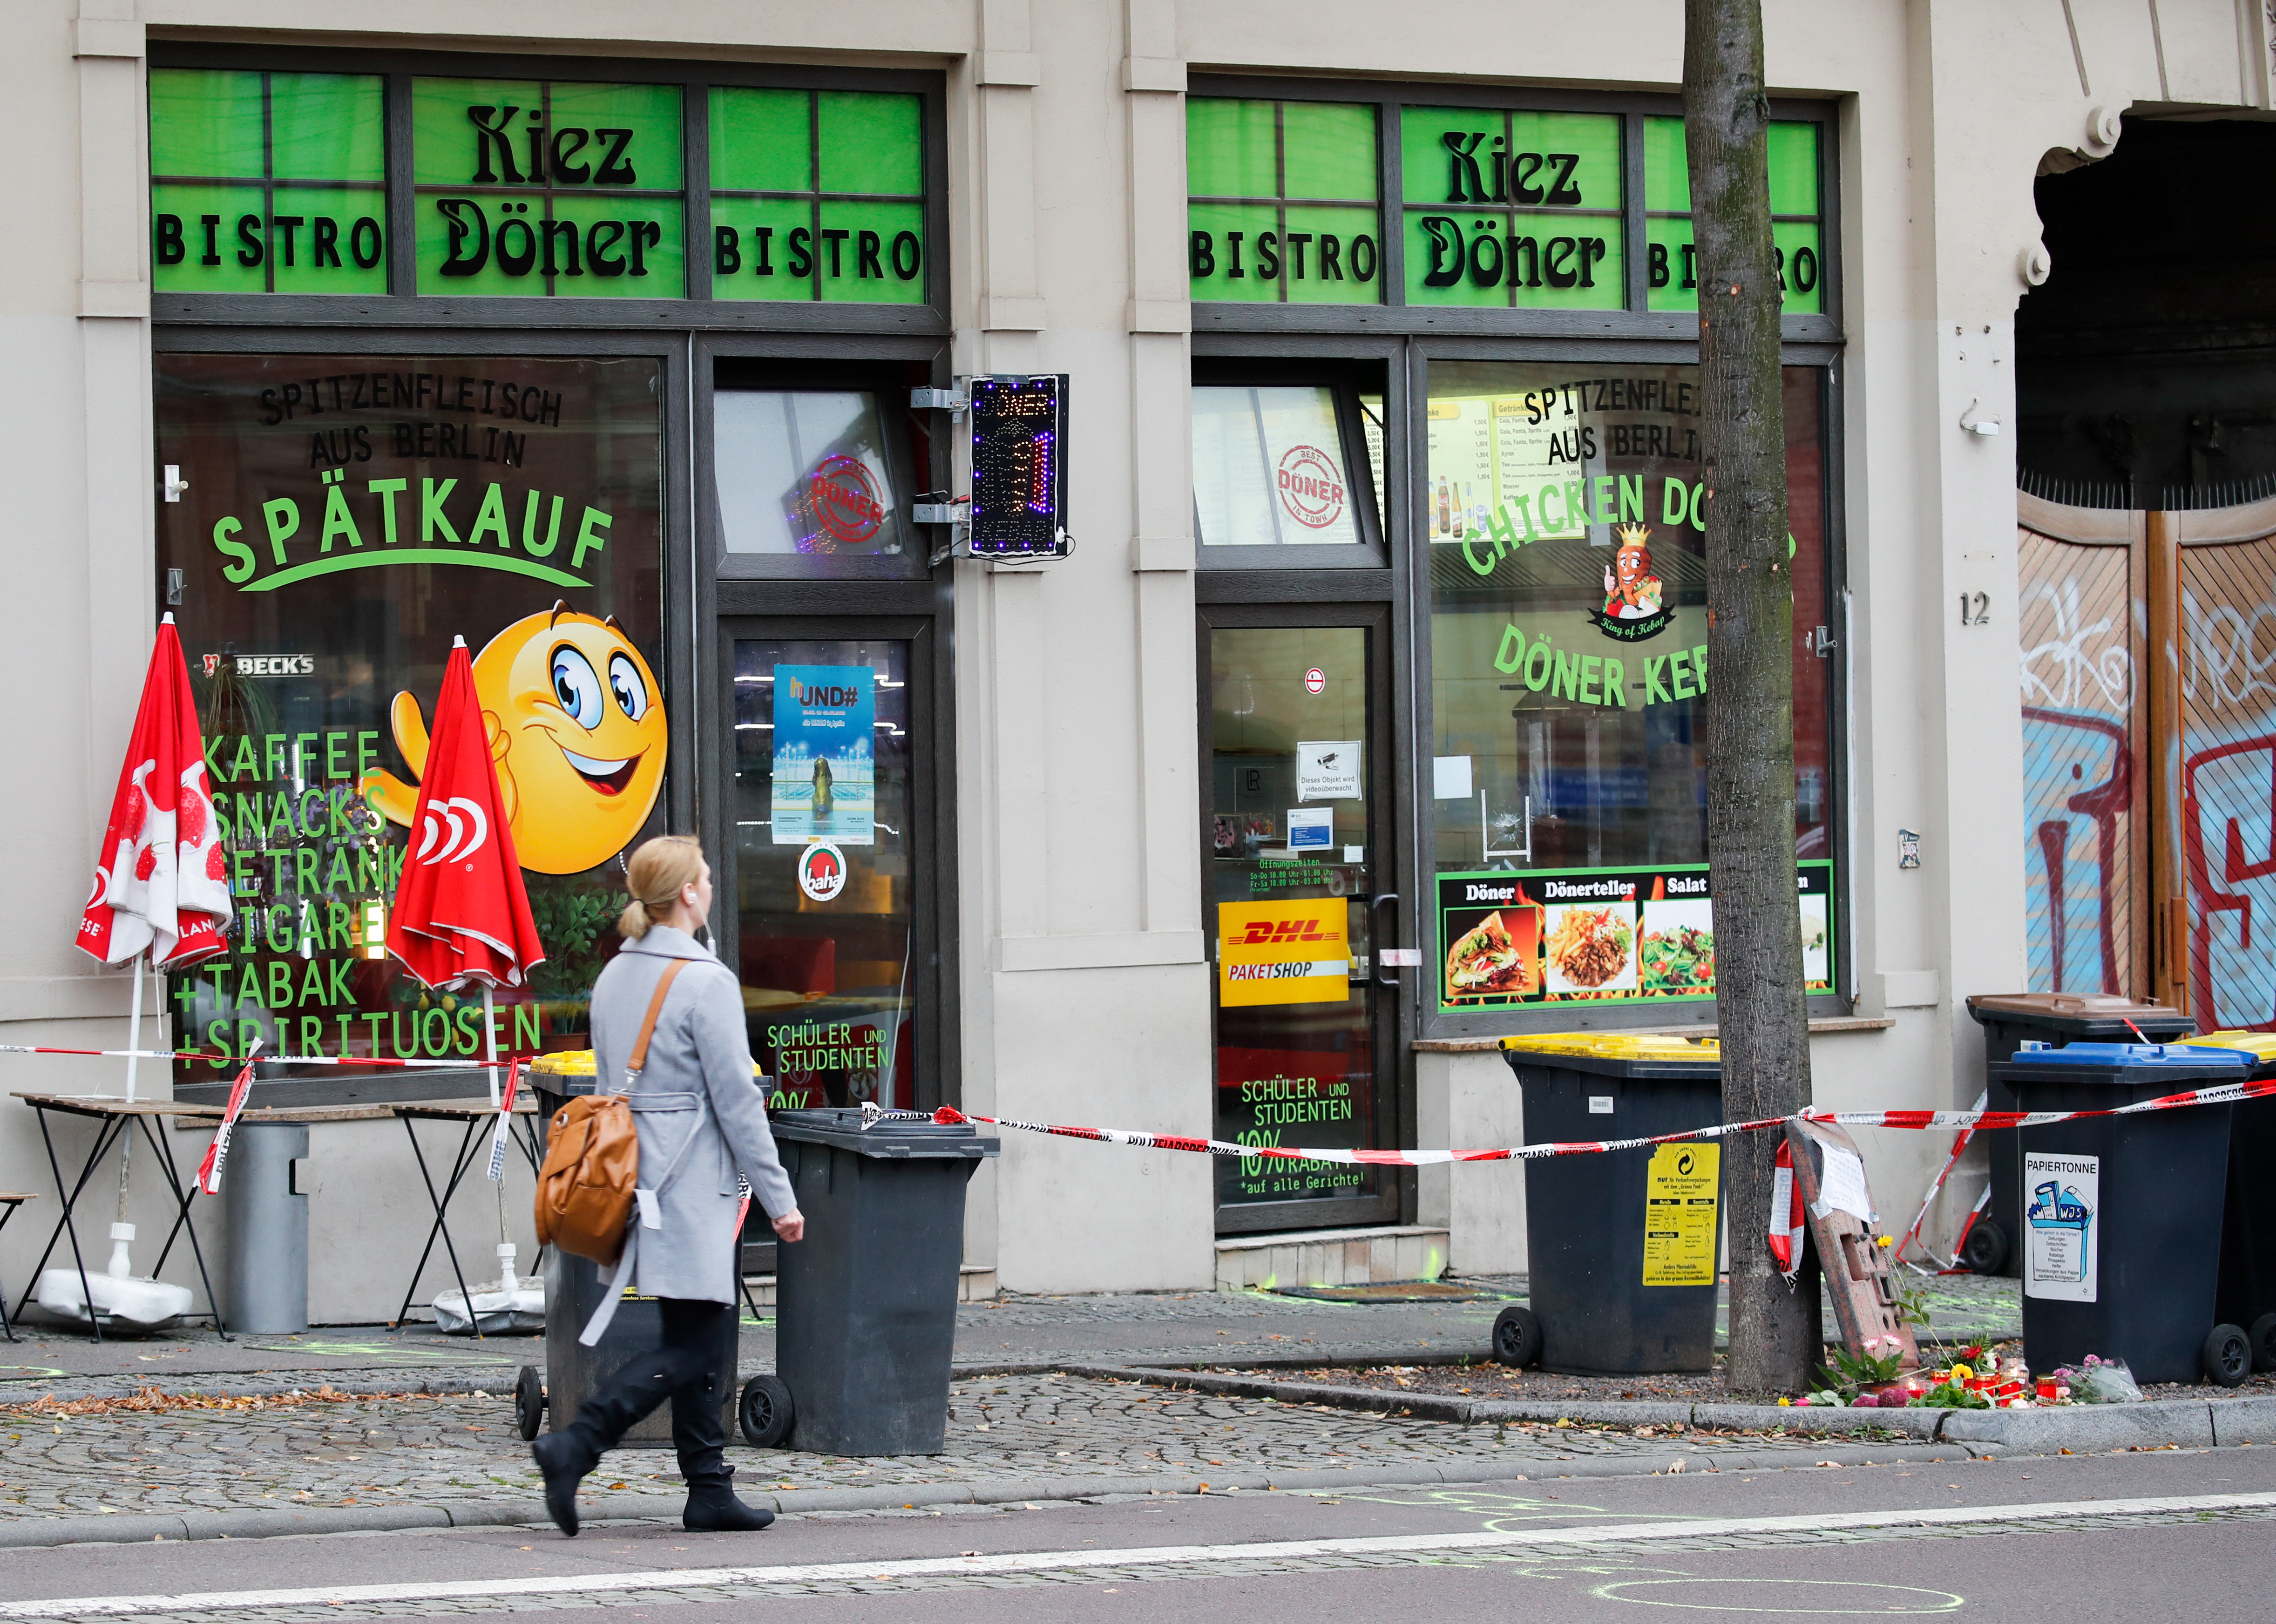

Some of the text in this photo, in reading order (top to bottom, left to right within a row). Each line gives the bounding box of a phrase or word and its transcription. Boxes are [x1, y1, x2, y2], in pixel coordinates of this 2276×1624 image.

[467, 106, 636, 184] Kiez
[1443, 131, 1582, 205] Kiez
[158, 214, 382, 269] BISTRO
[436, 198, 660, 277] Döner
[716, 226, 921, 281] BISTRO
[1422, 216, 1605, 288] Döner
[1192, 230, 1377, 283] BISTRO
[260, 373, 562, 427] SPITZENFLEISCH
[982, 389, 1048, 416] DÖNER
[1524, 379, 1700, 426] SPITZENFLE
[310, 422, 526, 469] AUS BERLIN
[1548, 424, 1701, 465] AUS BERLI
[812, 474, 883, 524] DÖNER
[1279, 469, 1344, 505] DÖNER
[213, 468, 613, 583] SPÄTKAUF
[1305, 513, 1328, 524] TOWN
[1462, 474, 1645, 576] CHICKEN
[1959, 590, 1991, 626] 12
[1600, 616, 1665, 639] King of Kebap
[237, 654, 314, 674] BECK'S
[1494, 623, 1626, 707] DÖNER
[202, 731, 382, 783] KAFFEE
[210, 785, 387, 841] SNACKS
[221, 836, 408, 899] ETRÄNK
[1260, 859, 1320, 869] Öffnungszeiten
[1270, 879, 1286, 887] 10.00
[1466, 885, 1515, 901] Döner
[1545, 880, 1636, 898] Dönerteller
[1667, 877, 1707, 893] Salat
[180, 919, 216, 939] LAN
[239, 900, 394, 954] IGARE
[1243, 919, 1325, 944] DHL
[1229, 962, 1312, 980] PAKETSHOP
[767, 1019, 887, 1048] SCHÜLER UND
[780, 1046, 889, 1073] STUDENTEN
[1241, 1075, 1349, 1103] SCHÜLER UND
[1255, 1099, 1352, 1126] STUDENTEN
[1274, 1178, 1300, 1191] alle
[2027, 1160, 2096, 1174] PAPIERTONNE
[2060, 1207, 2082, 1219] was
